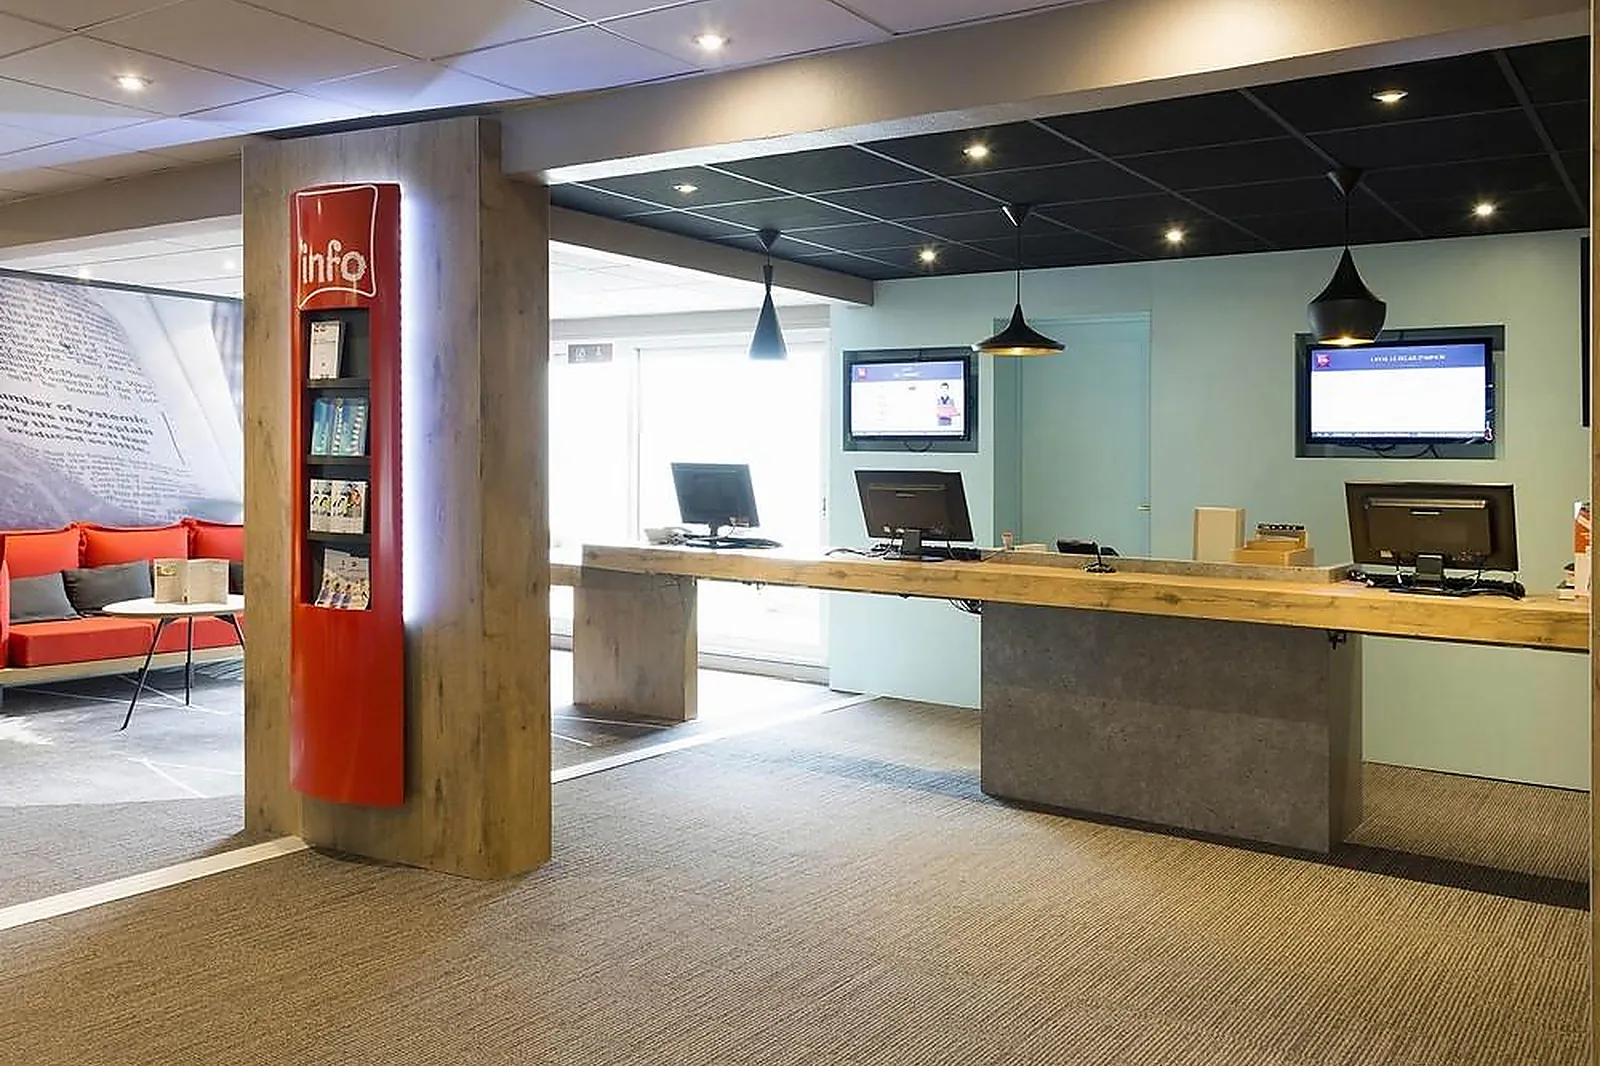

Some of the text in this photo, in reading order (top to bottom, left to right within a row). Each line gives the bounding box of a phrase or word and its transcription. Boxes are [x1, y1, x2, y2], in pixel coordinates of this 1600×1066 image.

[56, 404, 72, 412] of
[31, 420, 61, 430] the
[59, 416, 92, 428] may
[97, 421, 154, 437] explain
